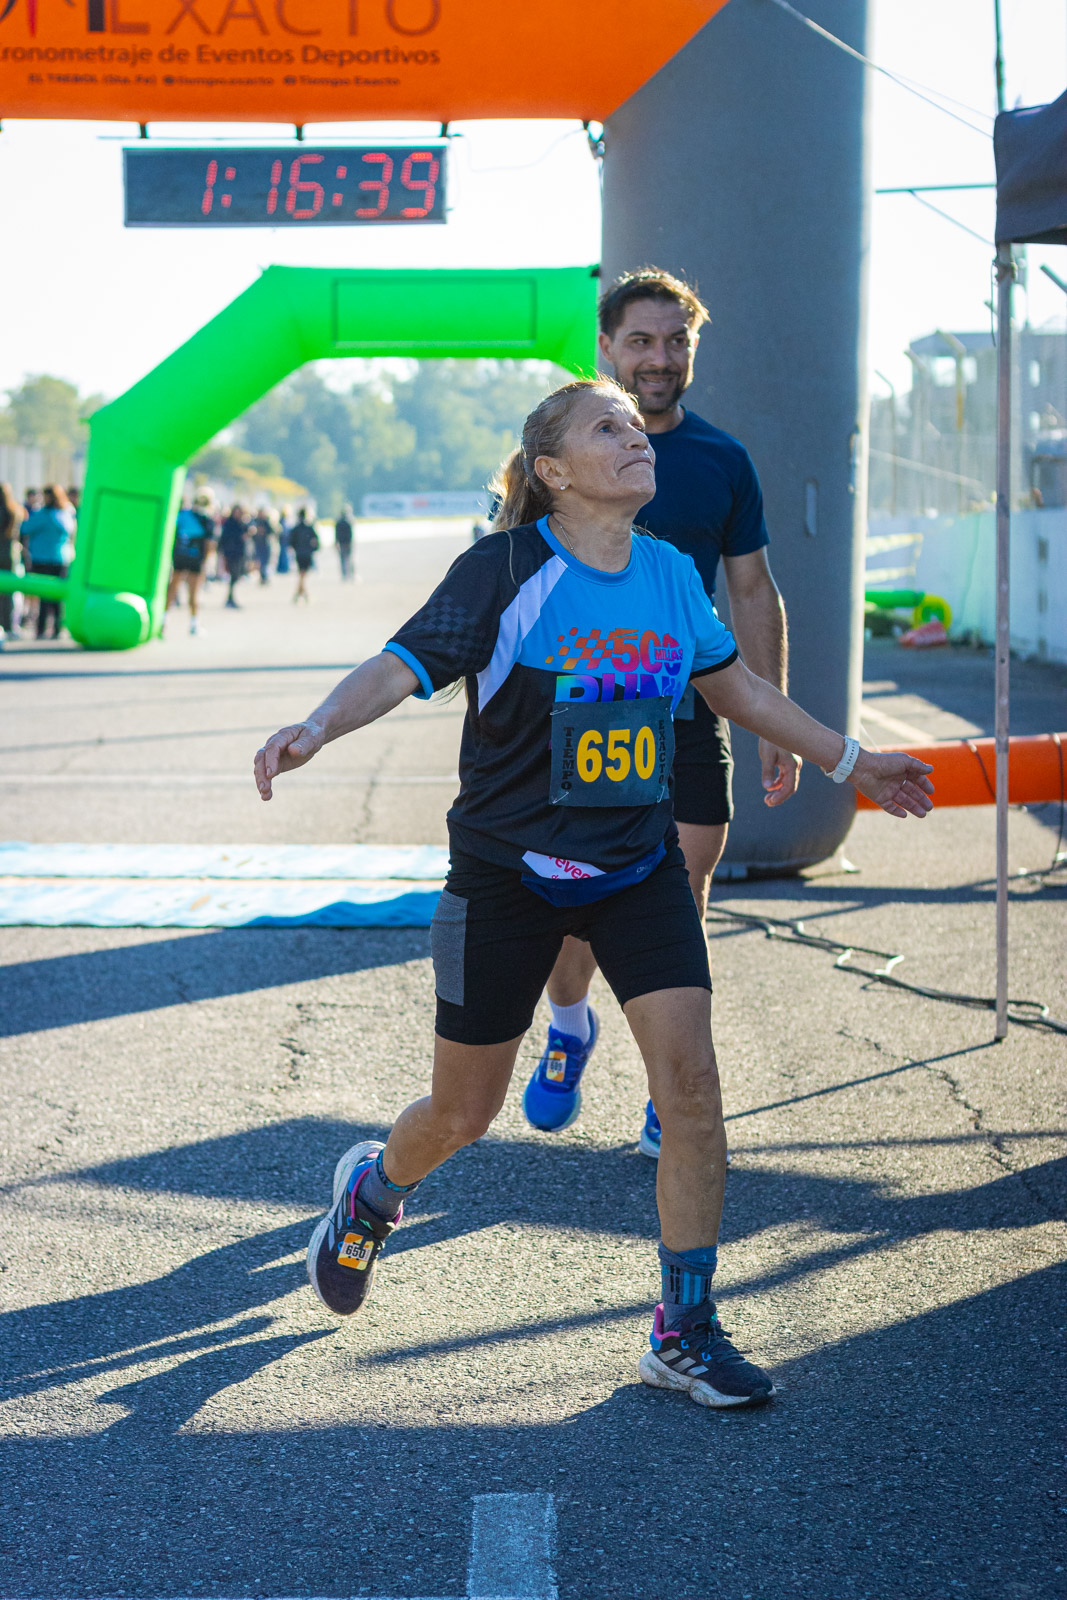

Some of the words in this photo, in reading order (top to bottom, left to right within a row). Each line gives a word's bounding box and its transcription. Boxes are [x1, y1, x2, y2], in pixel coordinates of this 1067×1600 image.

[0, 44, 153, 67] ronometraje
[158, 43, 189, 62] de
[196, 44, 295, 63] Eventos
[301, 44, 441, 67] Deportivos
[561, 726, 575, 791] TIEMPO
[576, 725, 656, 783] 650
[657, 720, 667, 784] EXACTO
[346, 1244, 367, 1259] 650
